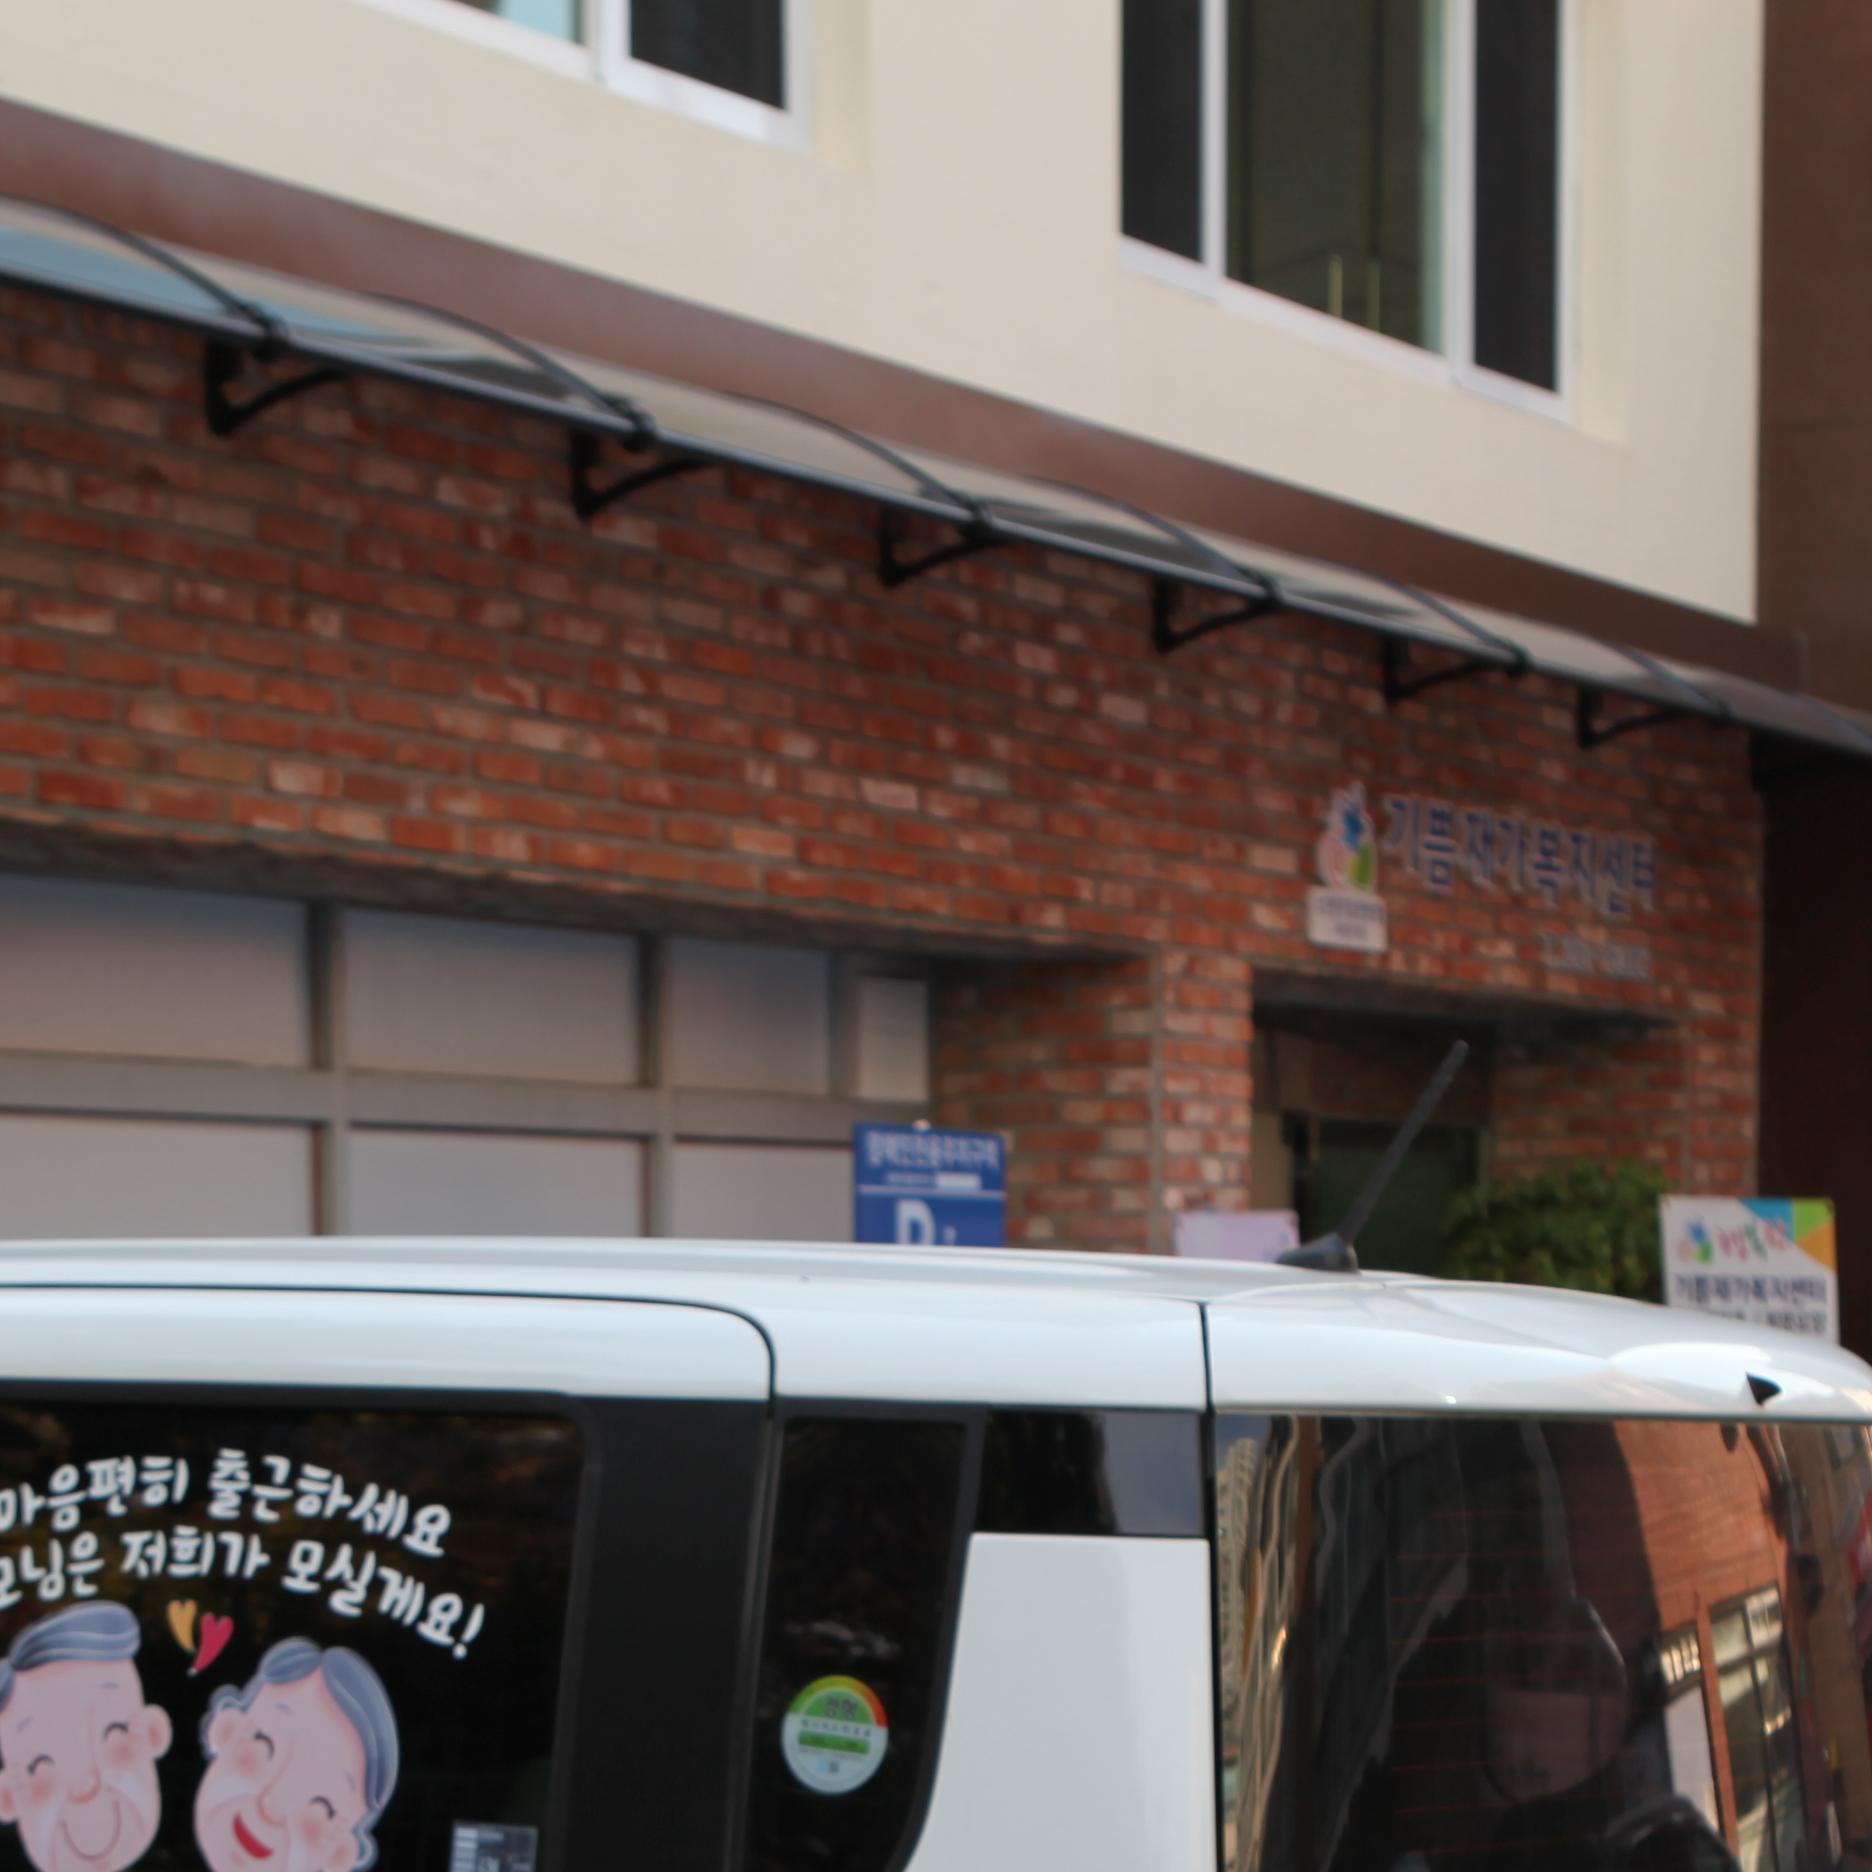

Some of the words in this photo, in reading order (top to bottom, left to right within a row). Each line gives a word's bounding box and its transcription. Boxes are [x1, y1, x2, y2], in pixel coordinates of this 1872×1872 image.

[207, 1447, 452, 1557] 출근하세요
[121, 1524, 269, 1579] 저희가
[282, 1540, 485, 1659] 모실게요!
